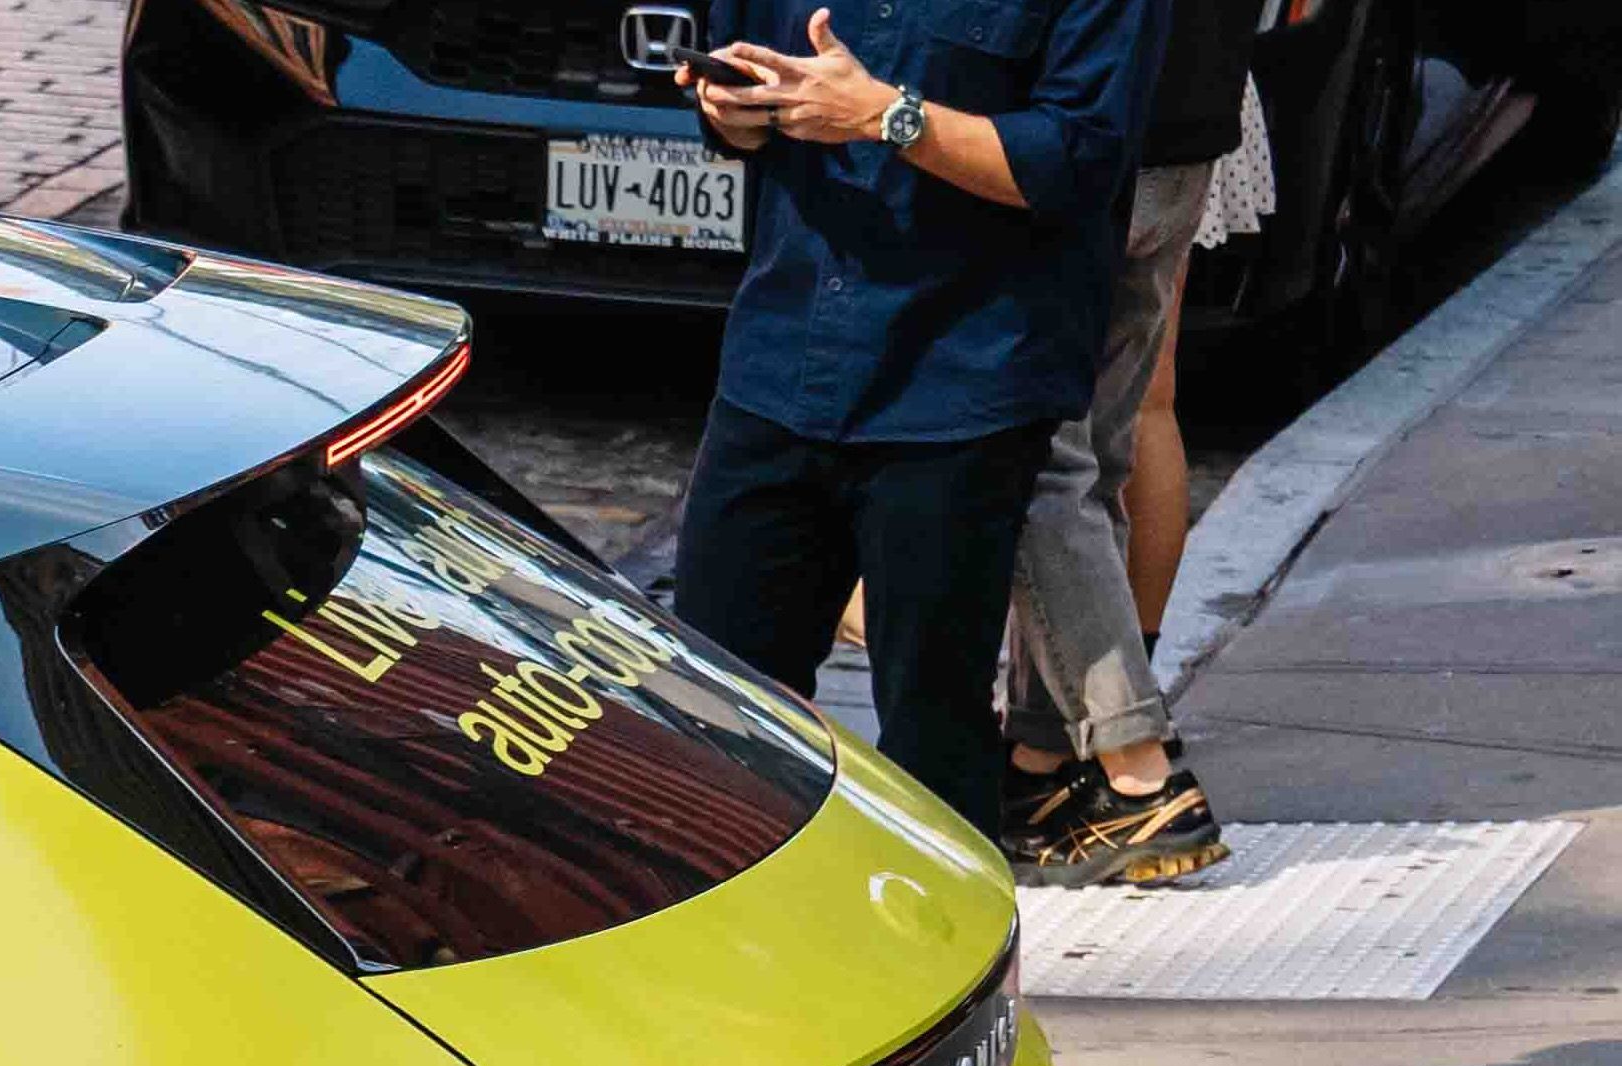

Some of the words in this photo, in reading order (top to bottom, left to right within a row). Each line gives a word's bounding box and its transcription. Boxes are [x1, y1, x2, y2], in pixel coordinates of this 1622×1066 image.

[644, 146, 701, 167] YORK
[556, 160, 620, 213] LUV
[648, 167, 735, 222] 4063
[261, 588, 441, 683] Live
